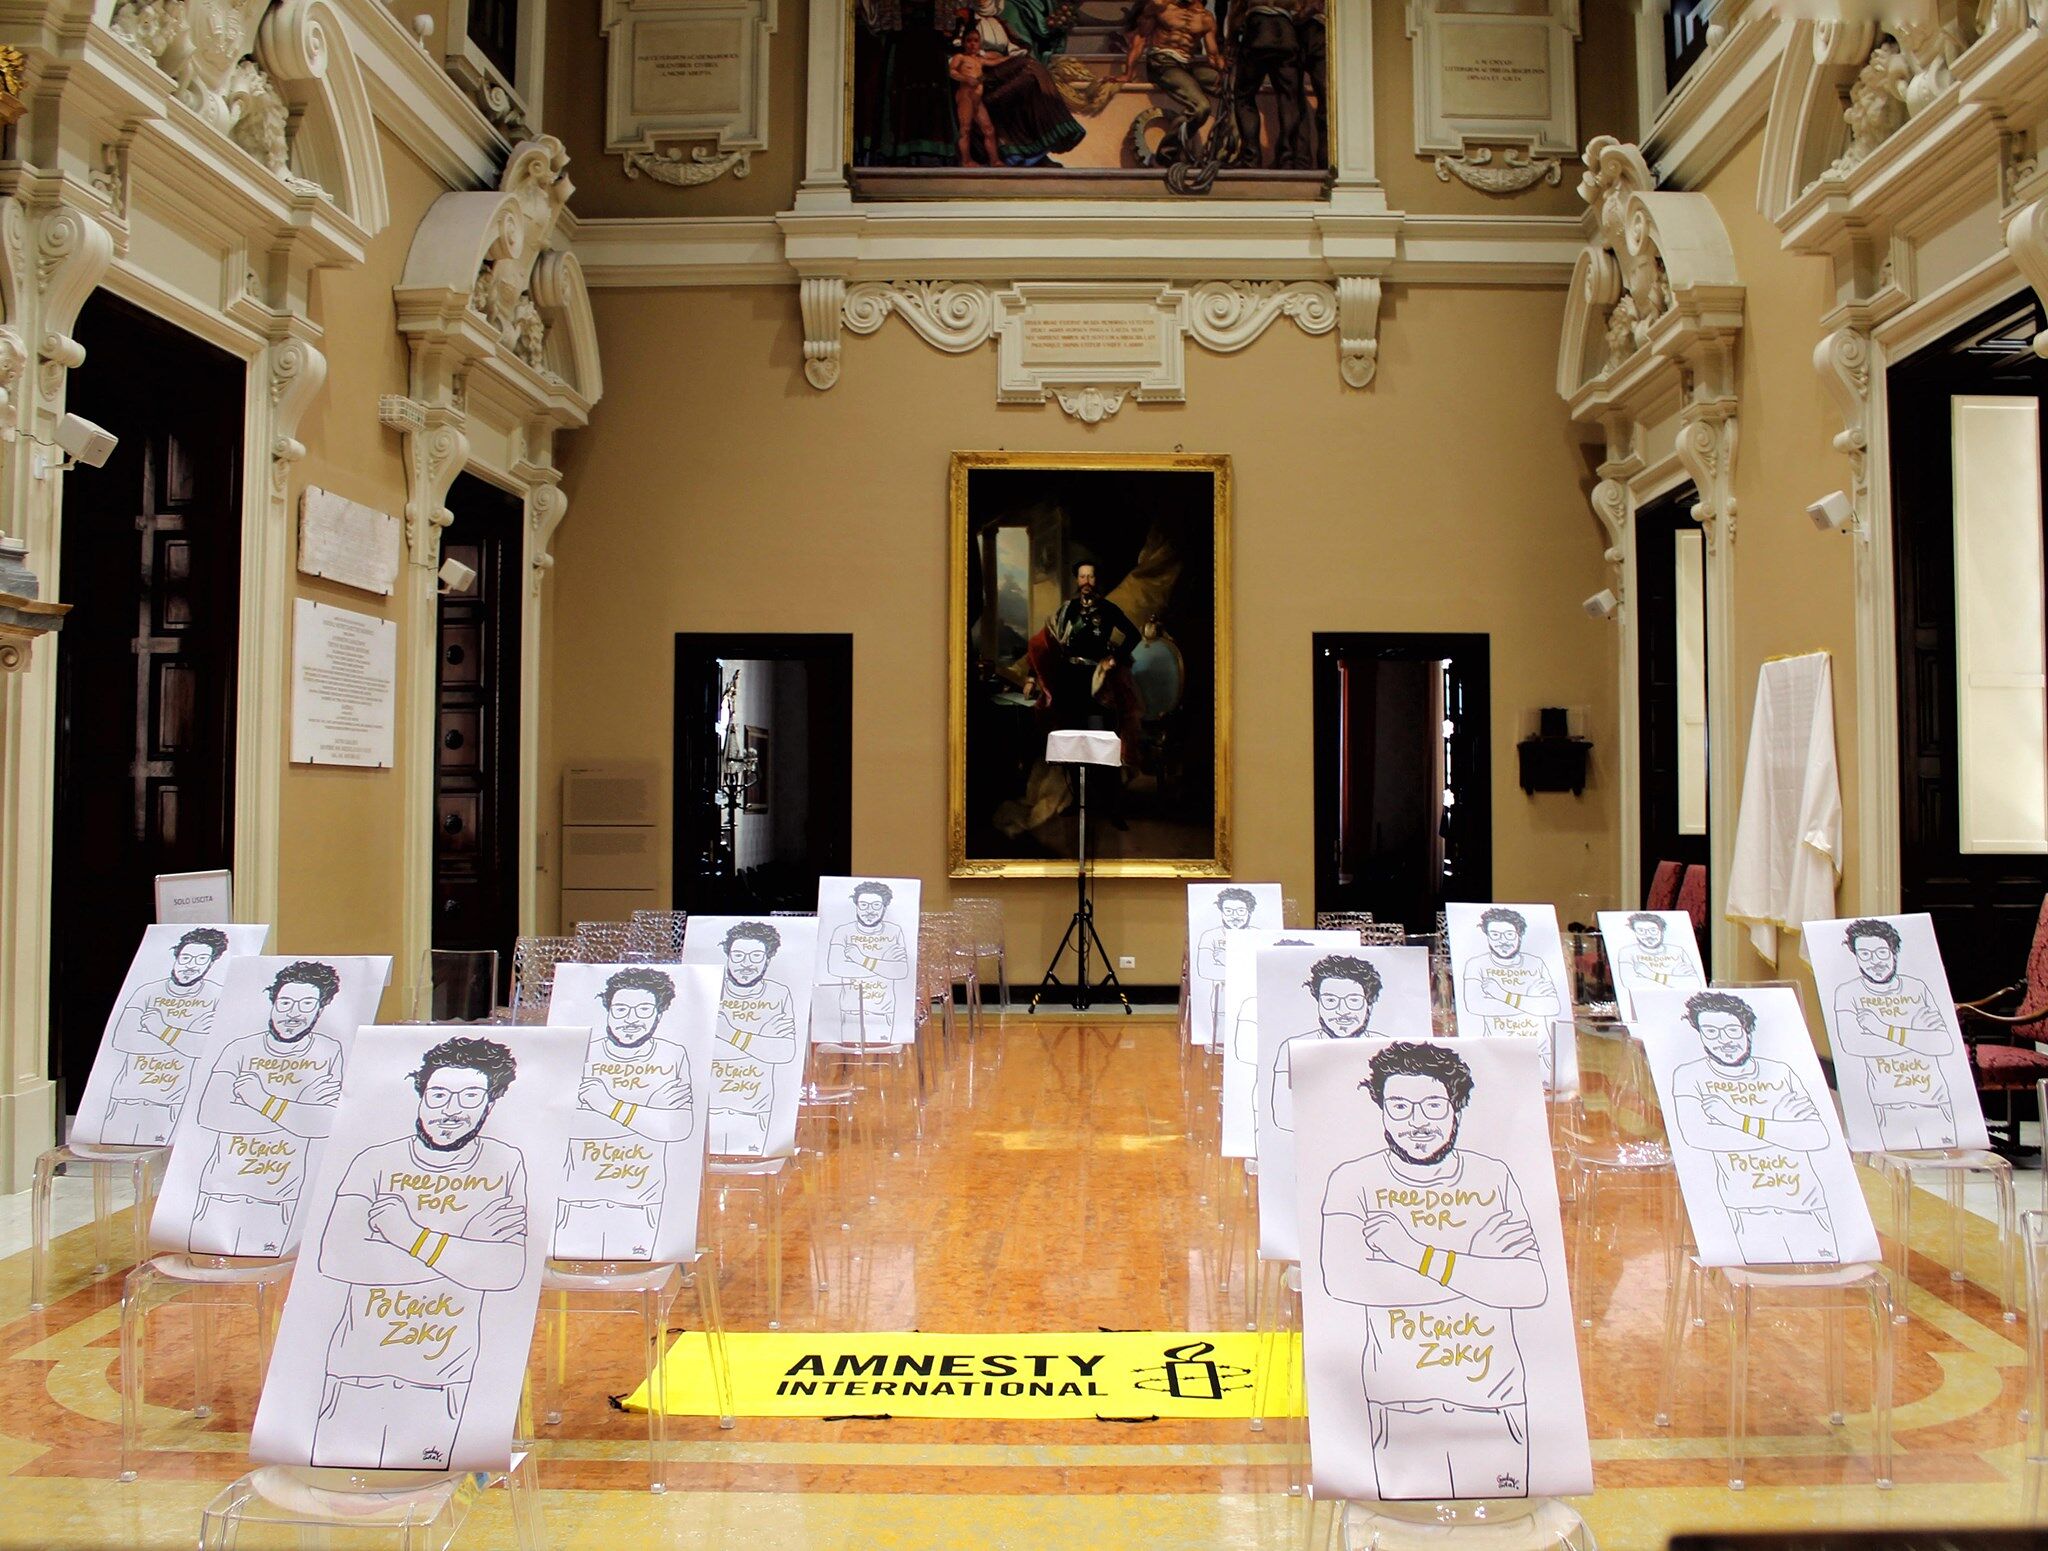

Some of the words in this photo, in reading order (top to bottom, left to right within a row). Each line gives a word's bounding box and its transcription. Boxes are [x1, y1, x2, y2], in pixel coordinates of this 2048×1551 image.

[174, 898, 190, 906] SOLO
[192, 896, 213, 904] USCITA
[1501, 978, 1526, 986] FOR
[167, 1008, 193, 1018] FOR
[732, 1011, 761, 1022] FOR
[1879, 1007, 1908, 1017] FOR
[268, 1072, 302, 1084] FOR
[612, 1077, 649, 1090] FOR
[1730, 1093, 1767, 1105] FOR
[418, 1194, 468, 1214] FOR
[1411, 1210, 1467, 1231] FOR
[365, 1288, 464, 1319] Patrick
[1388, 1309, 1494, 1340] Patrick
[380, 1322, 458, 1360] Zaky
[785, 1355, 1106, 1376] AMNESTY
[1417, 1342, 1493, 1382] Zaky
[776, 1381, 1109, 1396] INTERNATIONAL
